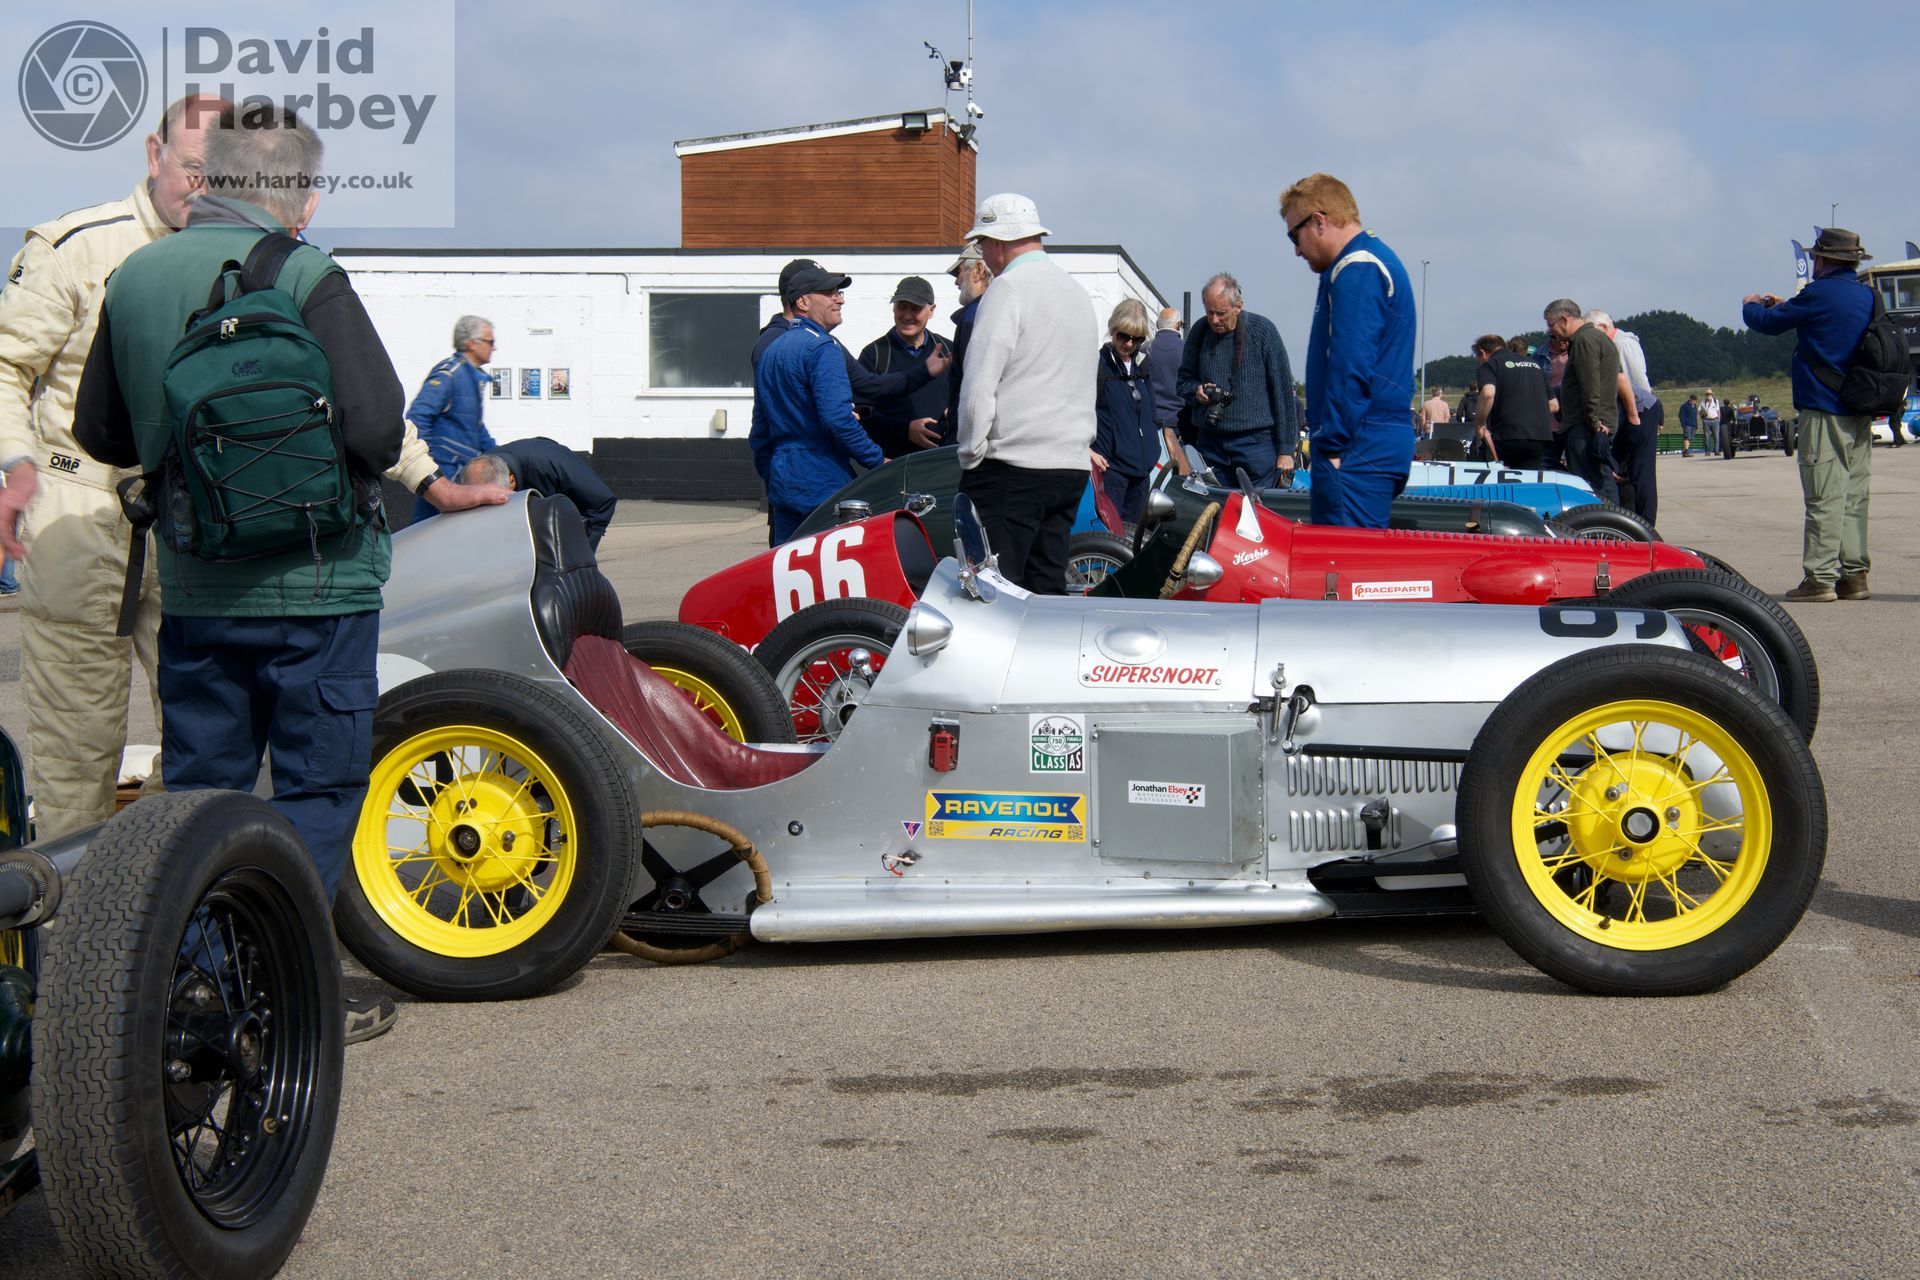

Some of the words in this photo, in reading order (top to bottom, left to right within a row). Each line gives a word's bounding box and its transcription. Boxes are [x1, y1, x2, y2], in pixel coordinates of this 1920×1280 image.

[50, 455, 81, 472] OMP
[1232, 547, 1270, 566] Herbie
[773, 525, 867, 624] 66
[1364, 585, 1431, 594] RACEPARTS
[1090, 665, 1219, 684] SUPERSNORT
[1034, 751, 1065, 769] CLASS
[1068, 751, 1081, 769] AS
[1131, 783, 1167, 792] Jonathan
[1168, 785, 1188, 795] Elsey
[944, 799, 1068, 817] RAVENOL
